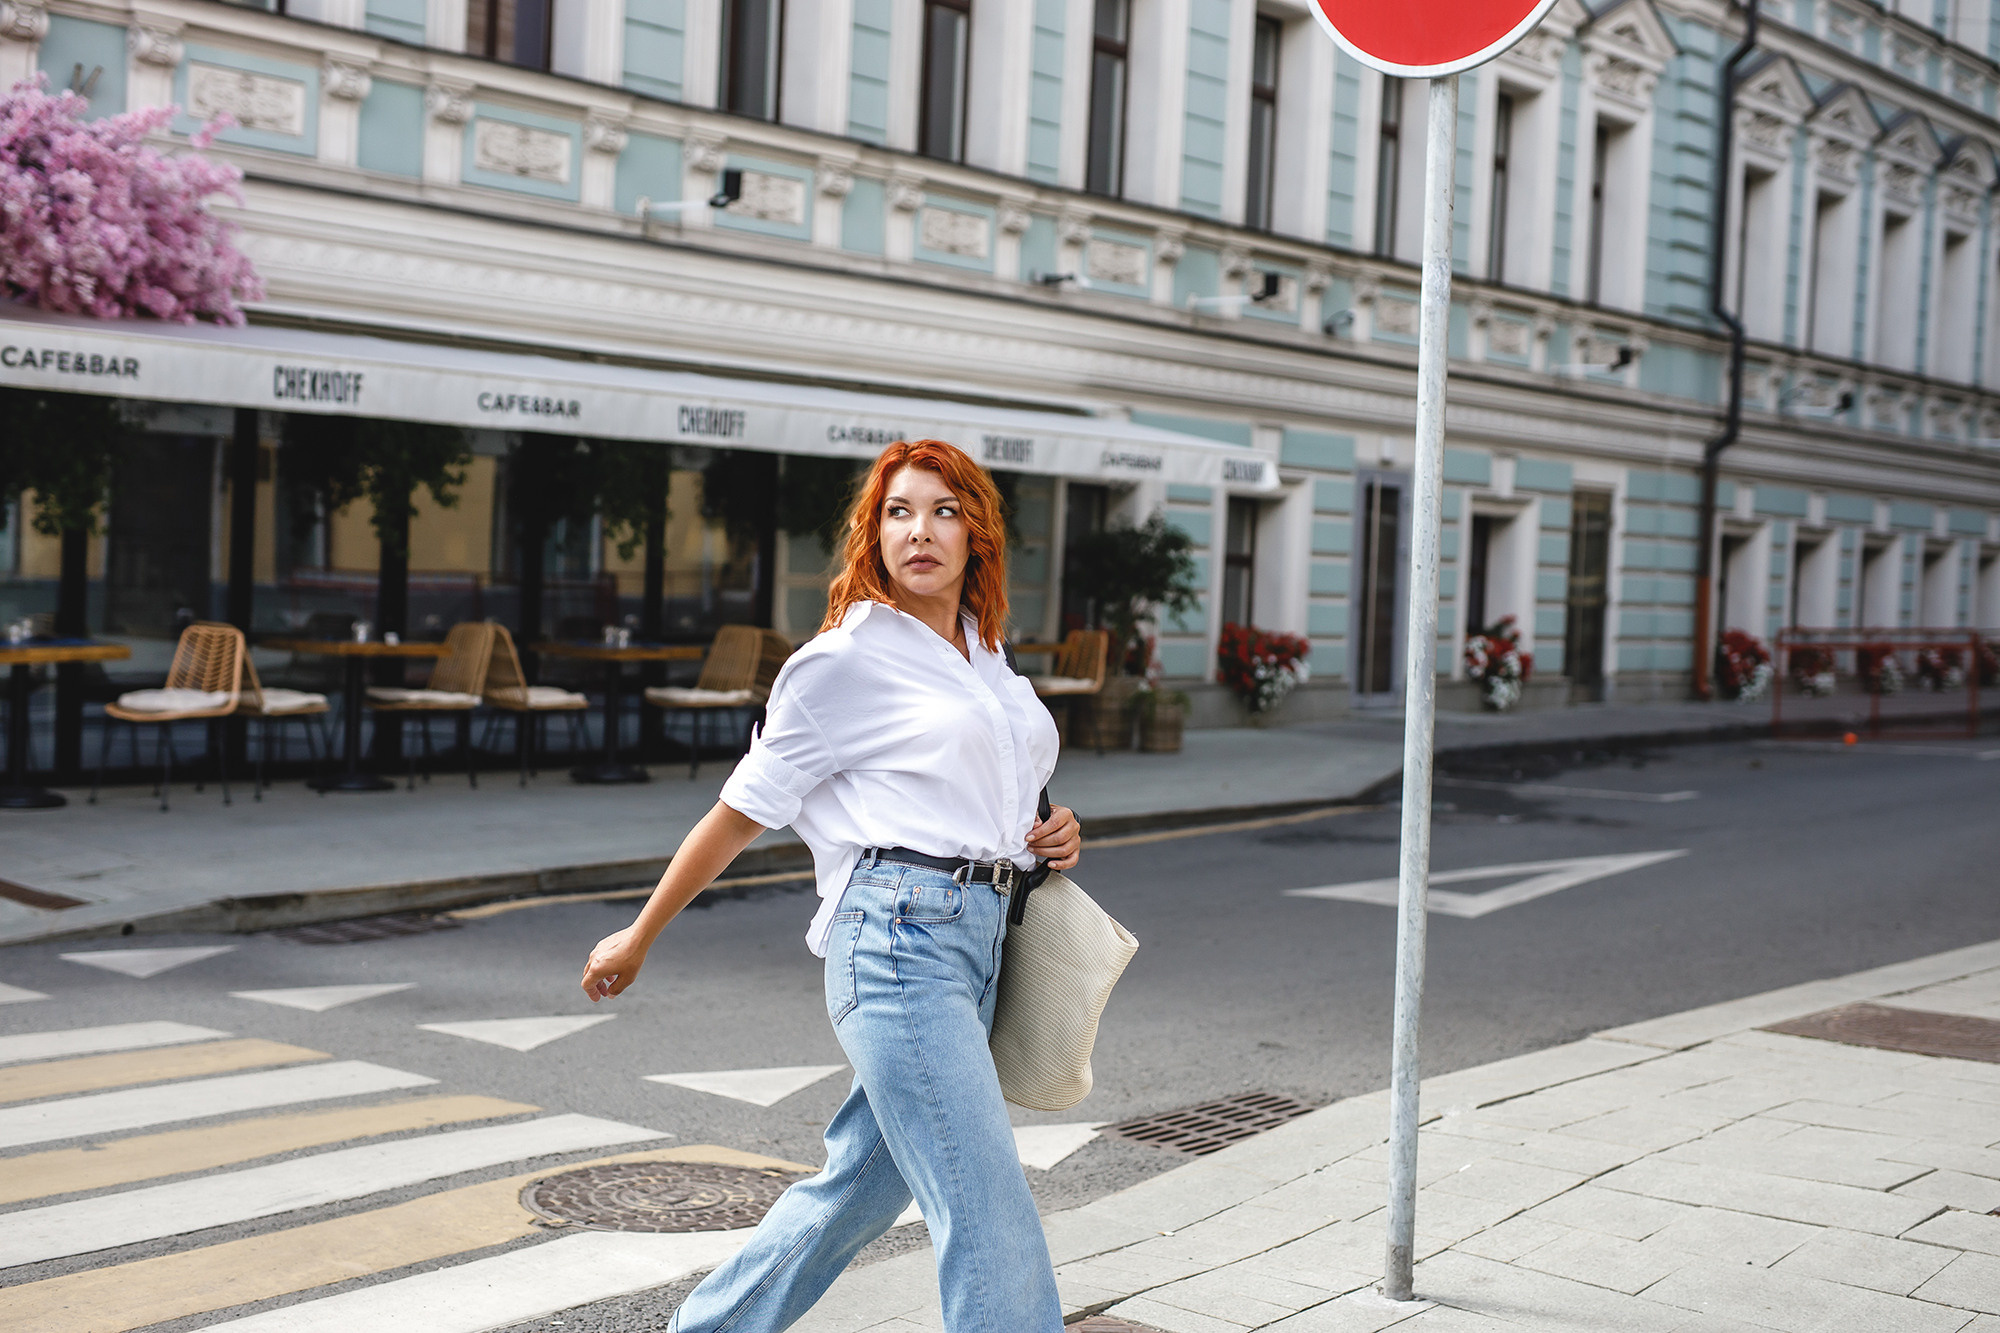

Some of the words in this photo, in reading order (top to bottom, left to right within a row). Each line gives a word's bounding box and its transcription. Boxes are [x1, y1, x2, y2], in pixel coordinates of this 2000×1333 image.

[1, 346, 140, 378] CAFE&BAR
[273, 365, 363, 404] CHEKHOFF
[477, 391, 581, 419] CAFE&BAR
